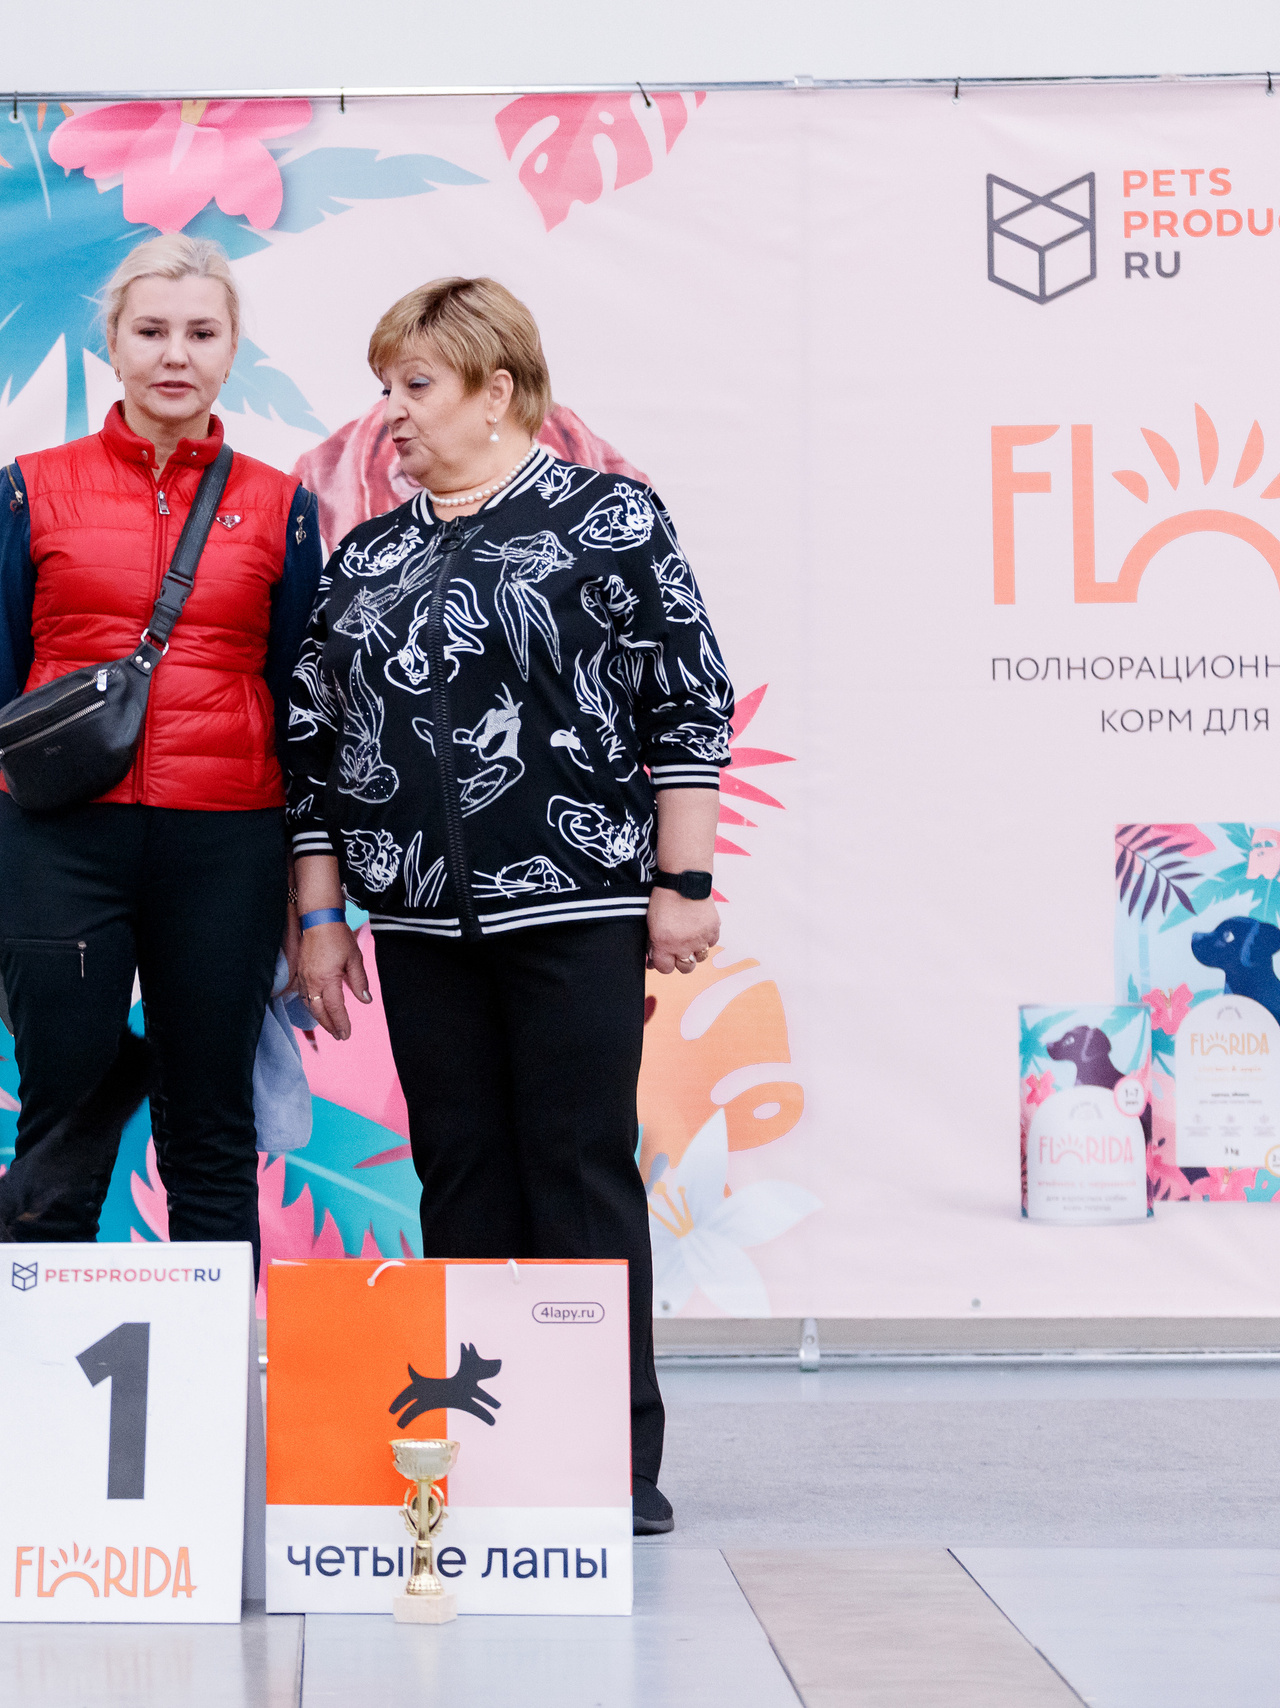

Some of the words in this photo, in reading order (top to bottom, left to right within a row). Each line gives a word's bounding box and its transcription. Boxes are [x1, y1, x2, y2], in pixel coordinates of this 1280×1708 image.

[1123, 167, 1233, 198] PETS
[1124, 250, 1181, 279] RU
[1101, 708, 1192, 733] КОРМ
[1203, 707, 1269, 736] ДЛЯ
[1190, 1032, 1270, 1056] FLORIDA
[1038, 1135, 1134, 1165] FLORIDA
[44, 1268, 222, 1283] PETSPRODUCTRU
[540, 1306, 595, 1321] 4lapy.ru
[75, 1322, 151, 1500] 1
[15, 1541, 198, 1598] FLORIDA
[286, 1545, 467, 1578] четые
[480, 1546, 608, 1579] лапы
